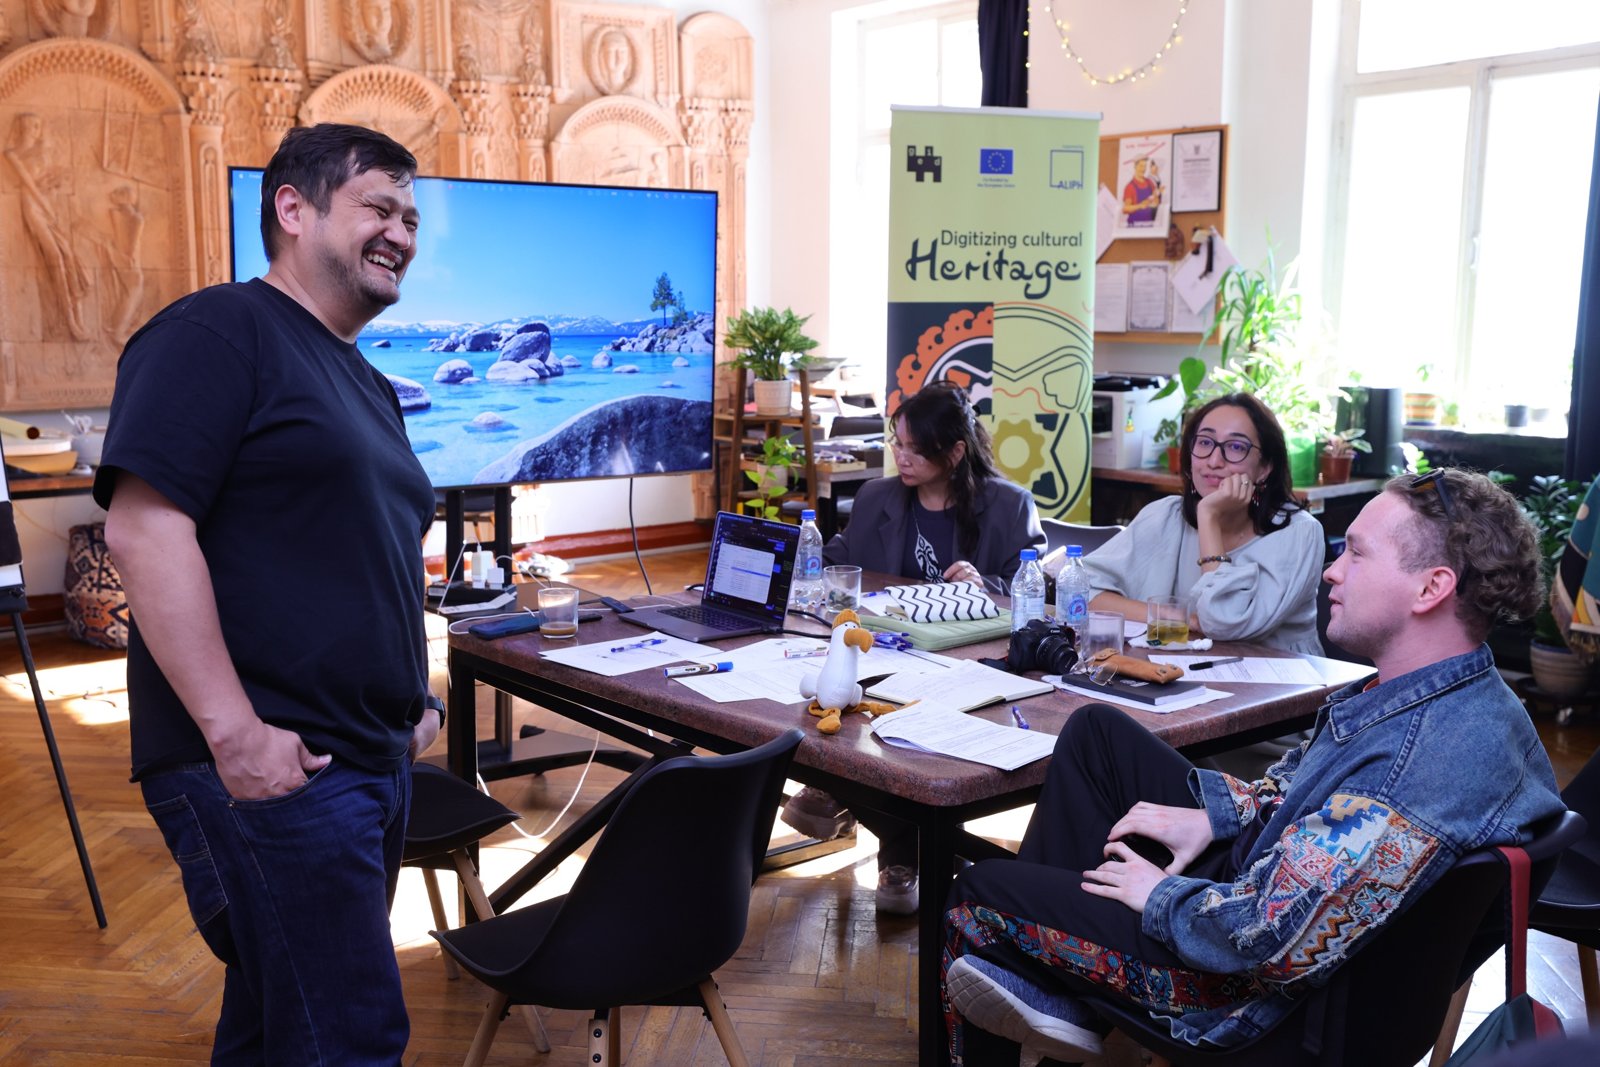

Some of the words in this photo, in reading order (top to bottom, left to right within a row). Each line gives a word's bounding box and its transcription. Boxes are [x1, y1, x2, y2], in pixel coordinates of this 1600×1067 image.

[1057, 180, 1084, 190] ALIPH
[941, 230, 1017, 248] Digitizing
[1022, 231, 1082, 247] cultural
[905, 237, 1081, 299] Heritage
